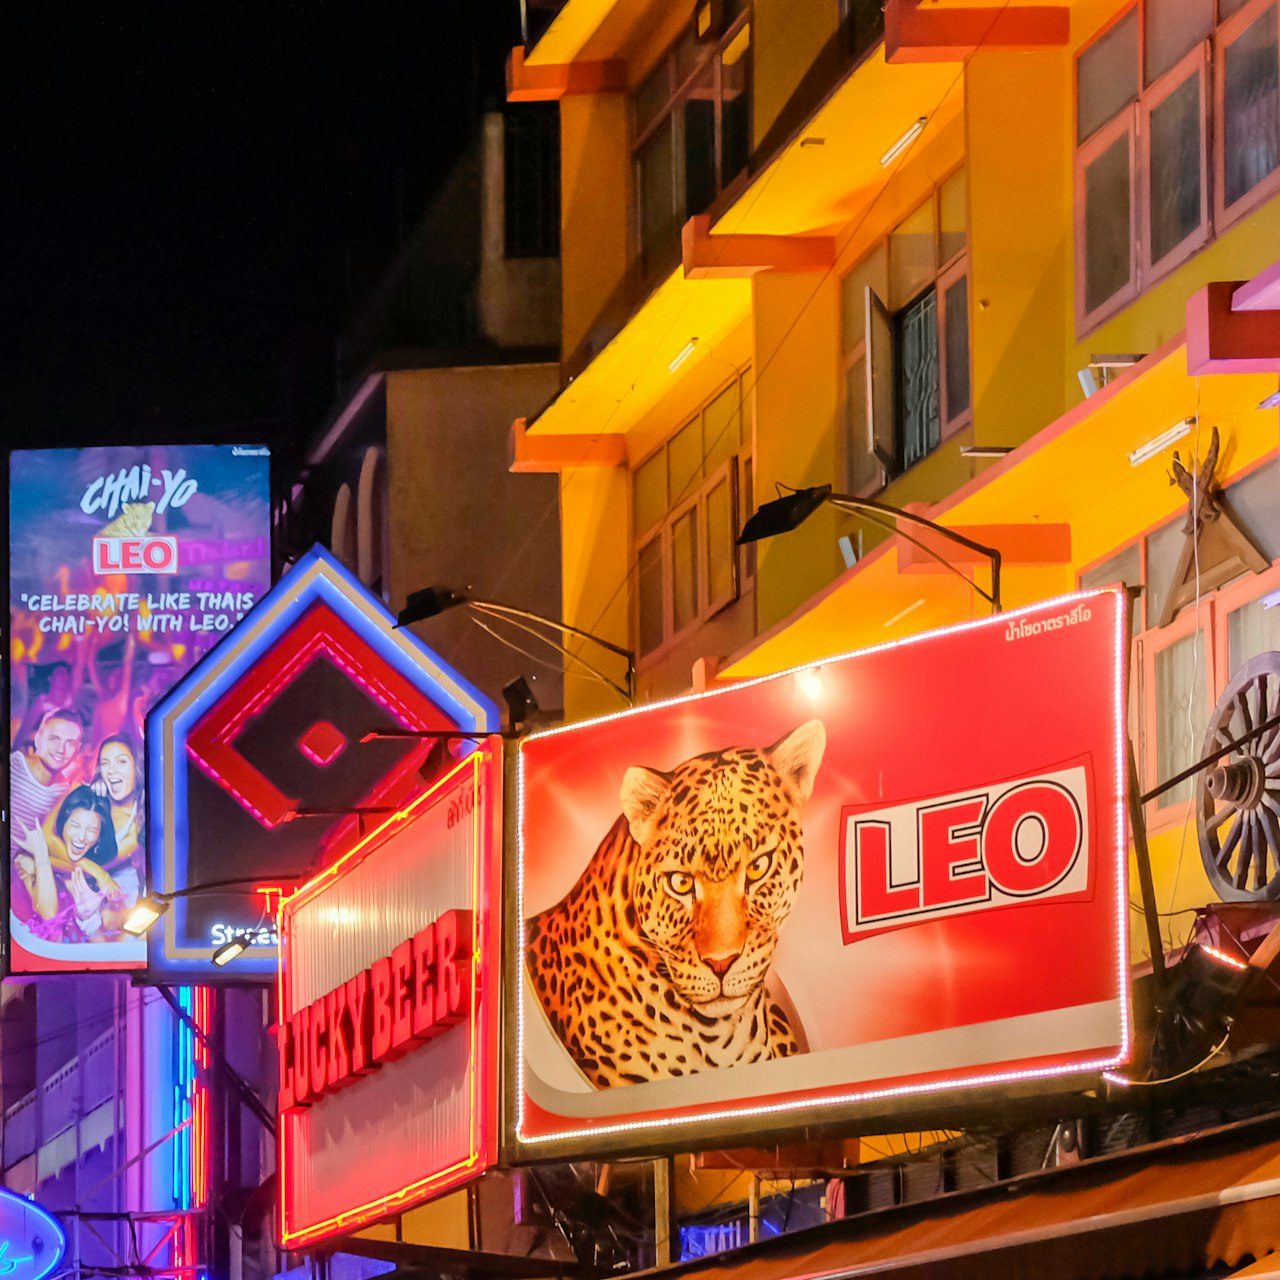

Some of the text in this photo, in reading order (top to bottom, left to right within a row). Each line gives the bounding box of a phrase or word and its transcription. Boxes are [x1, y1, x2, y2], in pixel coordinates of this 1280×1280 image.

[79, 464, 199, 519] CHAI-YO
[98, 539, 173, 571] LEO
[20, 591, 254, 612] "CELEBRATE LIKE THAIS
[39, 614, 130, 634] CHAI-YO!
[137, 614, 183, 633] WITH
[854, 778, 1084, 926] LEO
[278, 908, 465, 1104] LUCKY BEER
